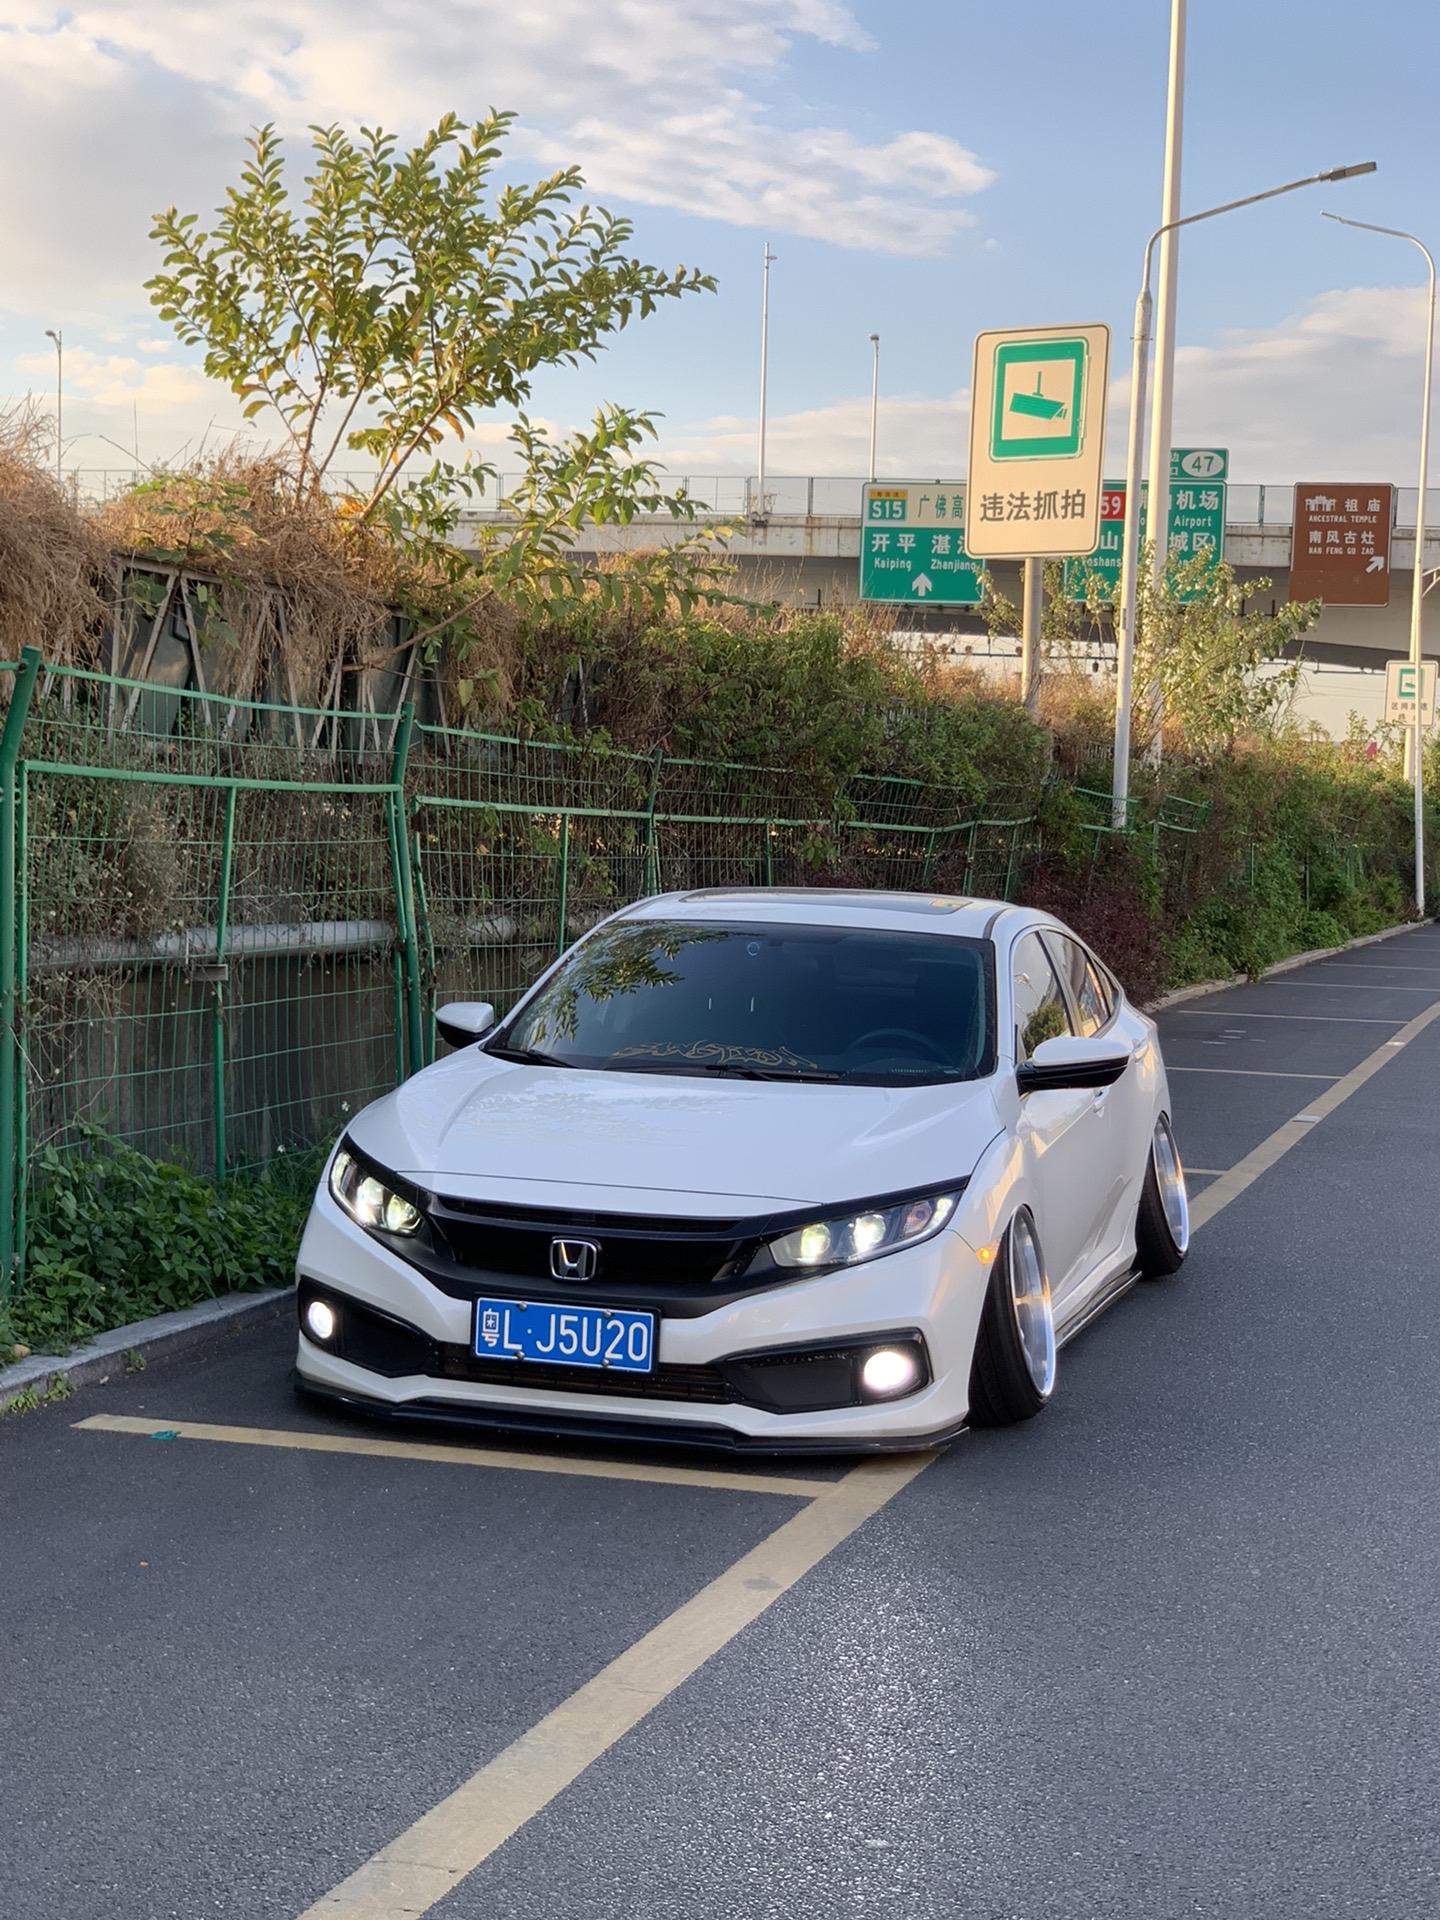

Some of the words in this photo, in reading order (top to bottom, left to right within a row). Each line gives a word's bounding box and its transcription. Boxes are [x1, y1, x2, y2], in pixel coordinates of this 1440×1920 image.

[1191, 456, 1215, 473] 47
[872, 500, 903, 518] S15
[979, 488, 1087, 522] 违法抓拍
[1344, 498, 1381, 512] 祖庙
[1174, 515, 1212, 528] Airport
[1308, 515, 1347, 523] ANCESTRAL
[1351, 515, 1377, 523] TEMPLE
[871, 533, 916, 554] 开平
[1308, 530, 1375, 545] 南风古灶
[1308, 547, 1322, 555] NAN
[1326, 547, 1343, 555] FENG
[874, 557, 912, 571] Kaiping
[930, 558, 976, 573] Zhanjiang
